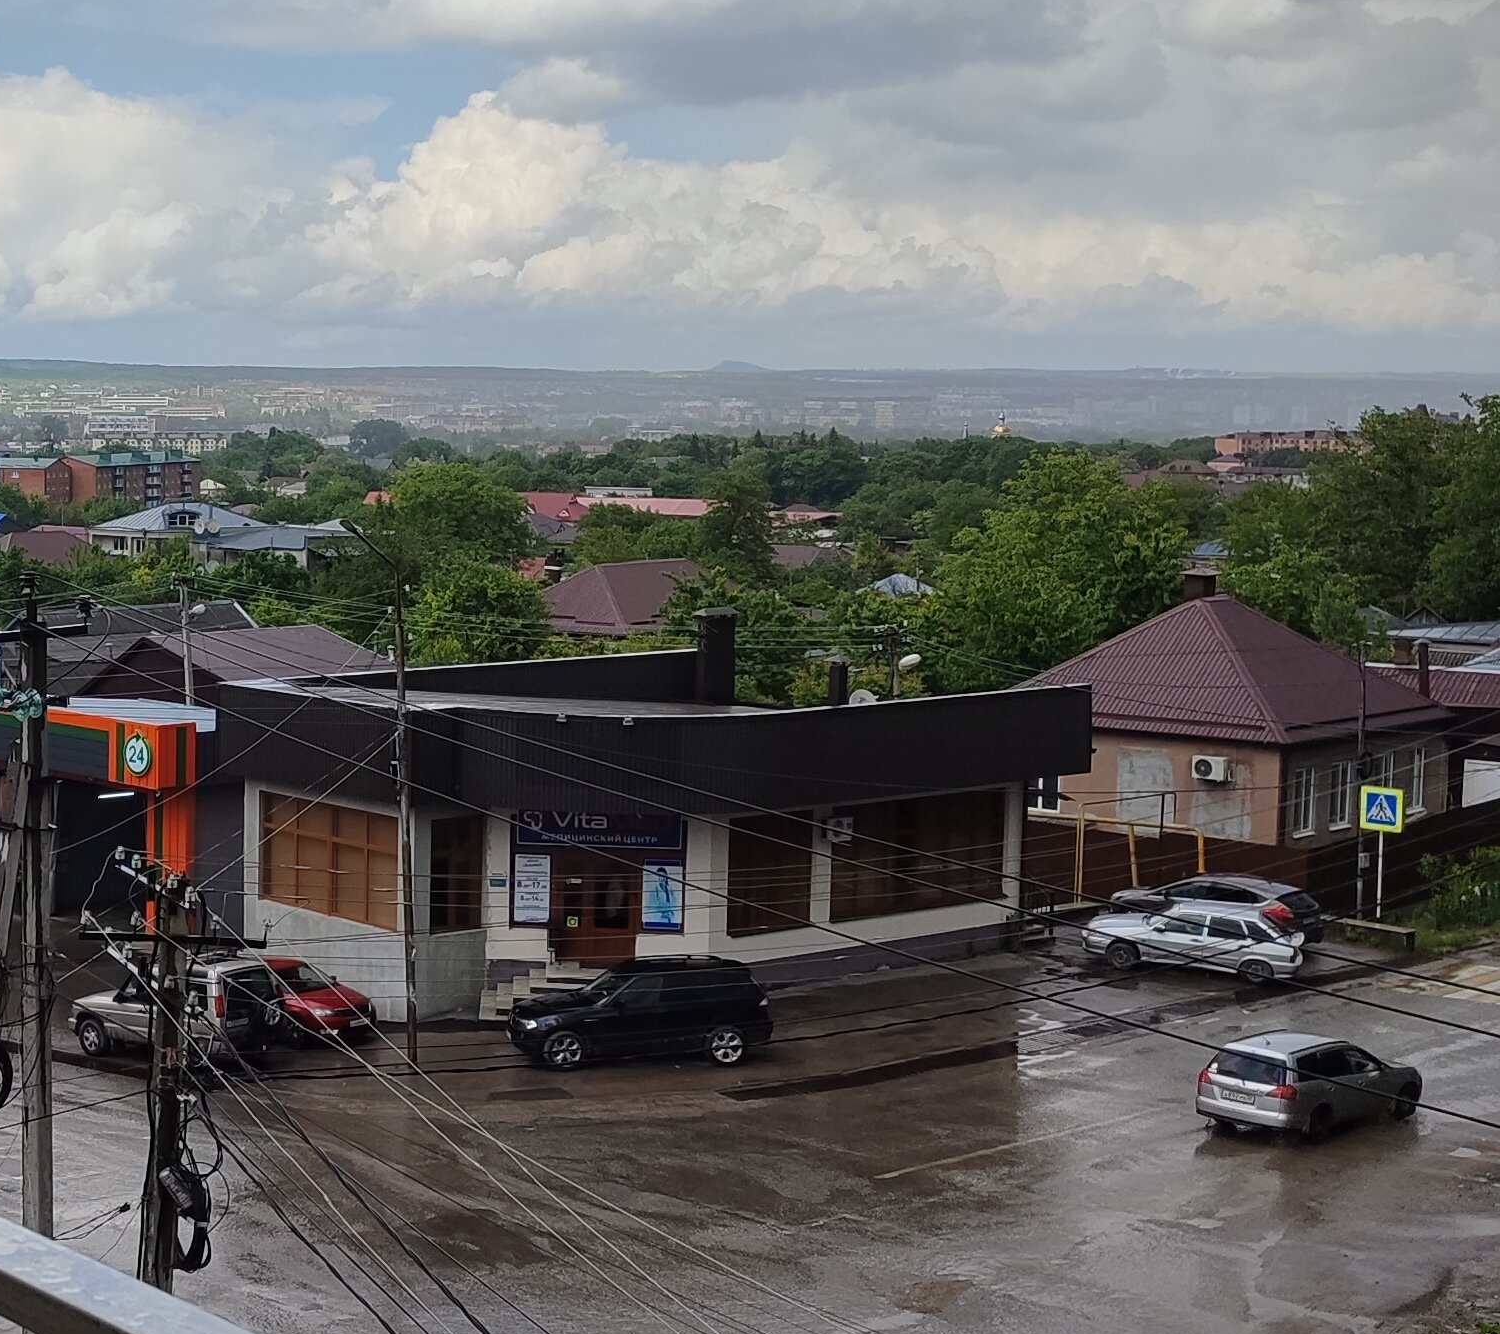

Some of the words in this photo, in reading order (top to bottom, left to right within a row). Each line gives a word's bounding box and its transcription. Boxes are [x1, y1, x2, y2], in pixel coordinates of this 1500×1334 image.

[128, 744, 145, 765] 24
[552, 811, 608, 829] Vita
[623, 836, 658, 844] ЦЕНТР
